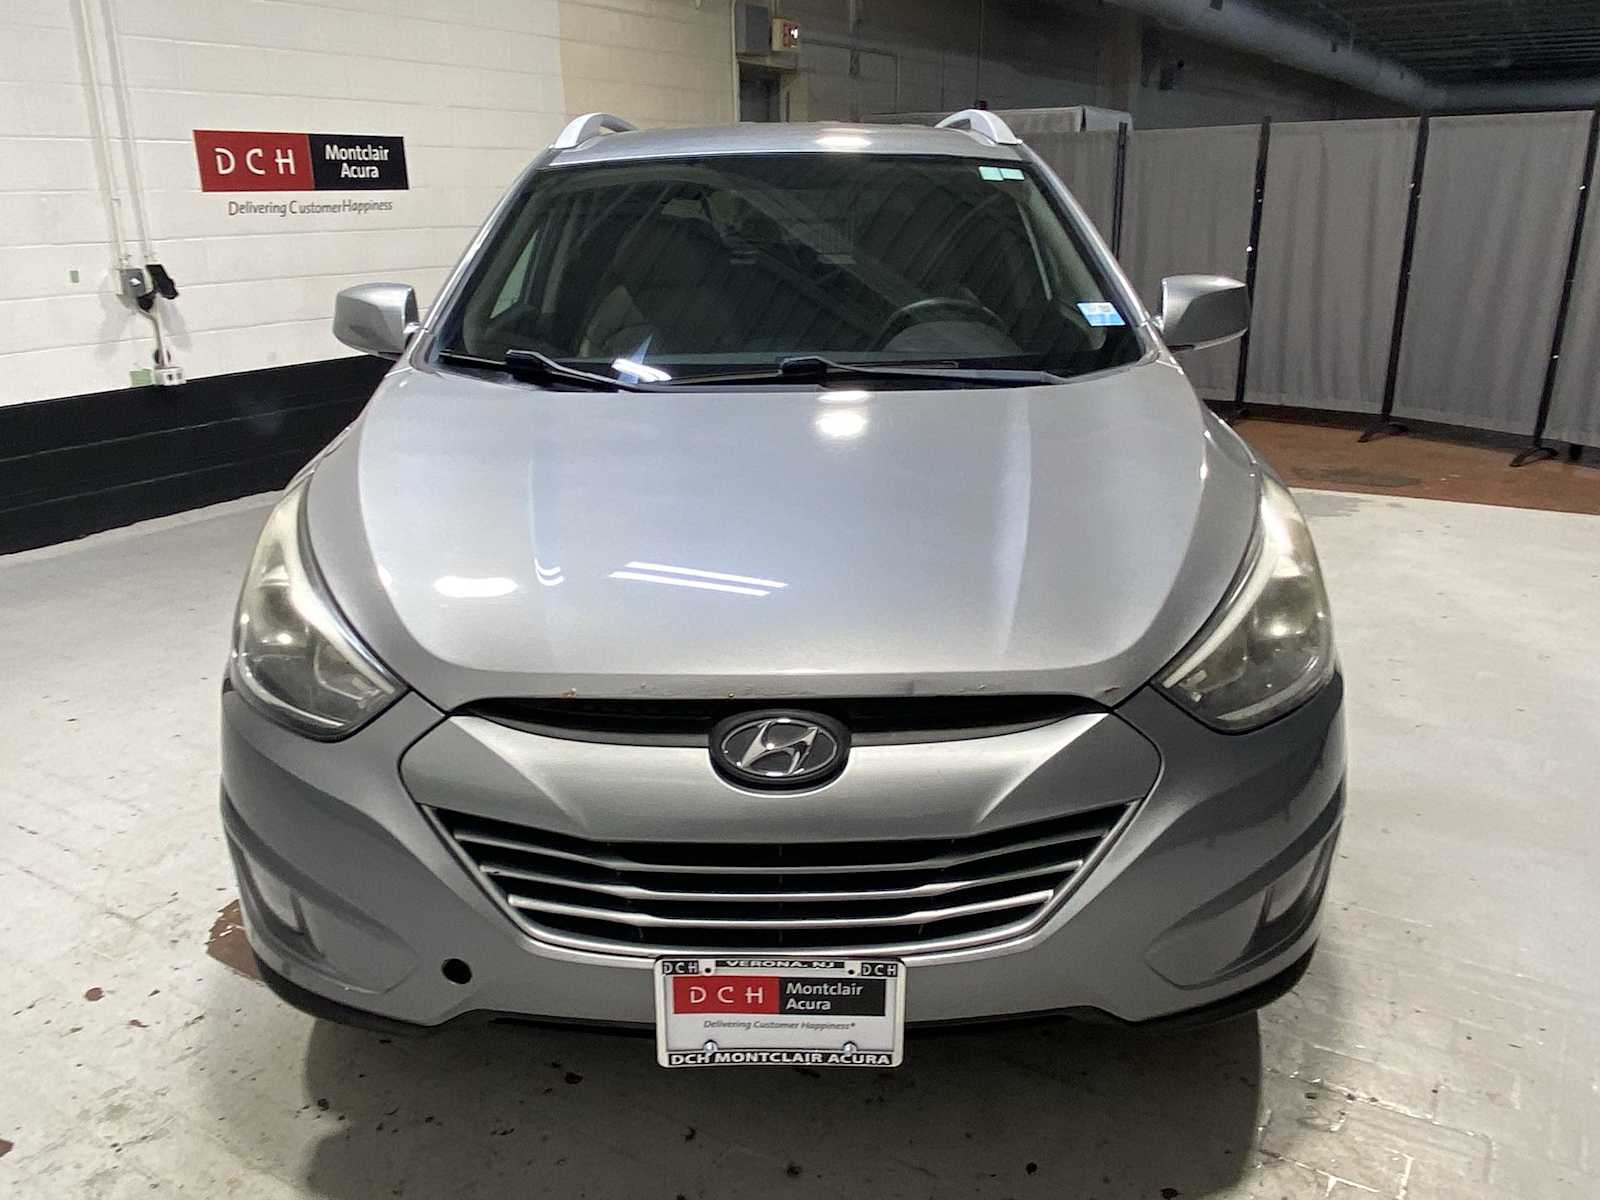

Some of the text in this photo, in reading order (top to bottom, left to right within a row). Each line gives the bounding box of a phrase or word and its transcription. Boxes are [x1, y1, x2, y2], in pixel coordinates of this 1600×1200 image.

[325, 144, 390, 161] Montclair
[340, 162, 380, 179] Acura
[228, 200, 288, 217] Delivering
[342, 199, 393, 214] Happiness
[785, 982, 864, 996] Montclair
[785, 997, 832, 1010] Acura
[703, 1020, 751, 1030] Delivering
[753, 1020, 799, 1030] Customer
[671, 1052, 891, 1065] DCH MONTCLAIR ACURA
